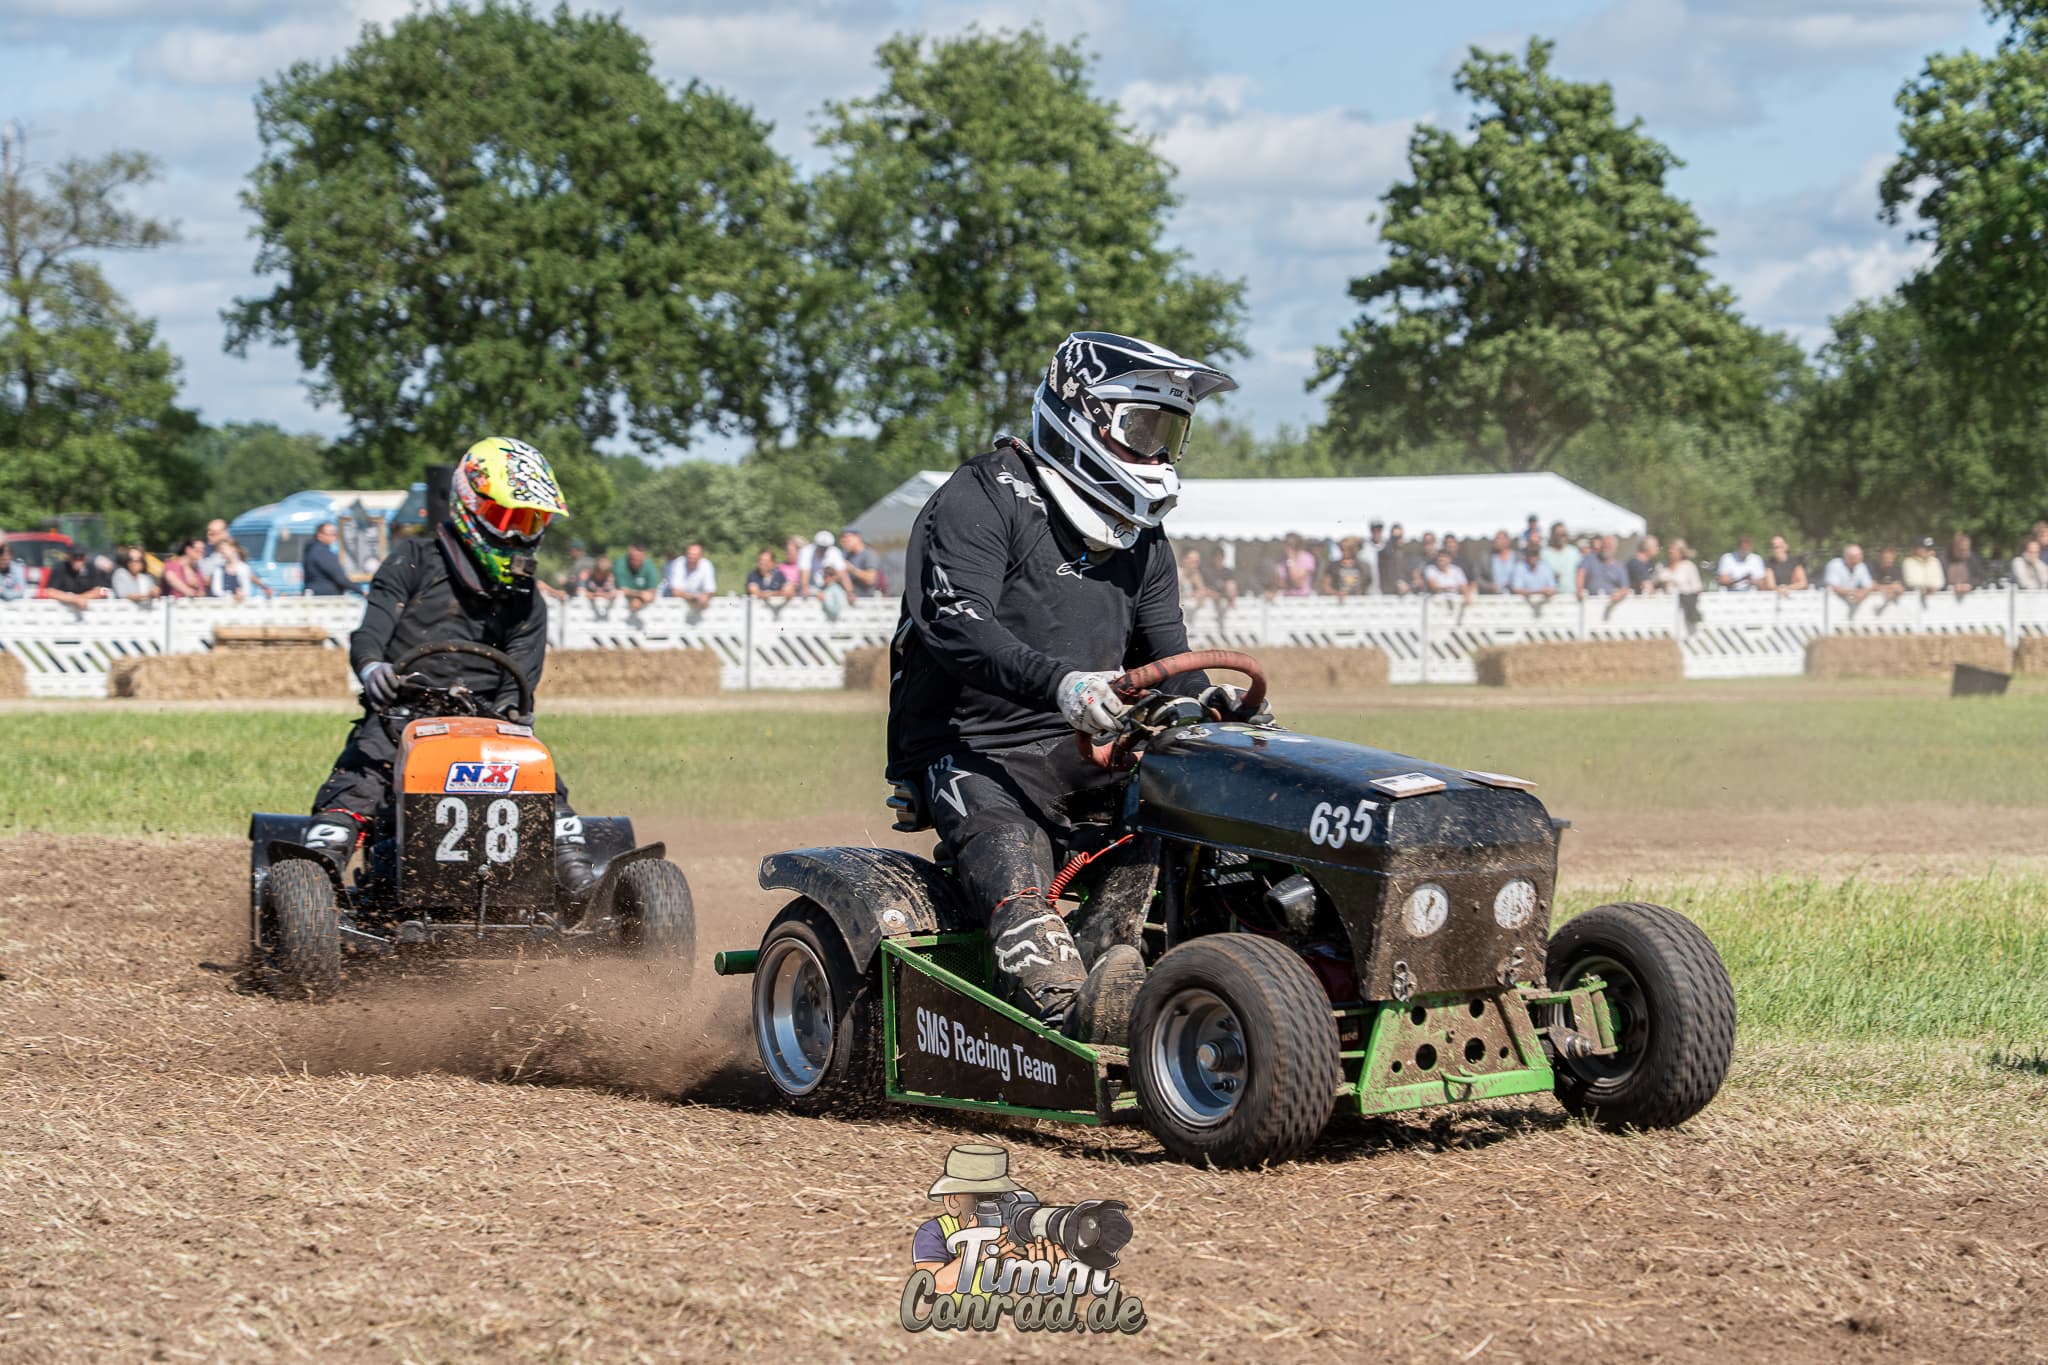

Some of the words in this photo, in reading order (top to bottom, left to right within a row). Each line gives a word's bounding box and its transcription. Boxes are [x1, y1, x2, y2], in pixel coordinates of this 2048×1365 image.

[1169, 387, 1184, 398] FOX
[452, 765, 513, 782] NX
[1310, 799, 1379, 849] 635
[916, 1006, 950, 1058] SMS
[953, 1020, 1011, 1081] Racing
[1012, 1043, 1057, 1085] Team
